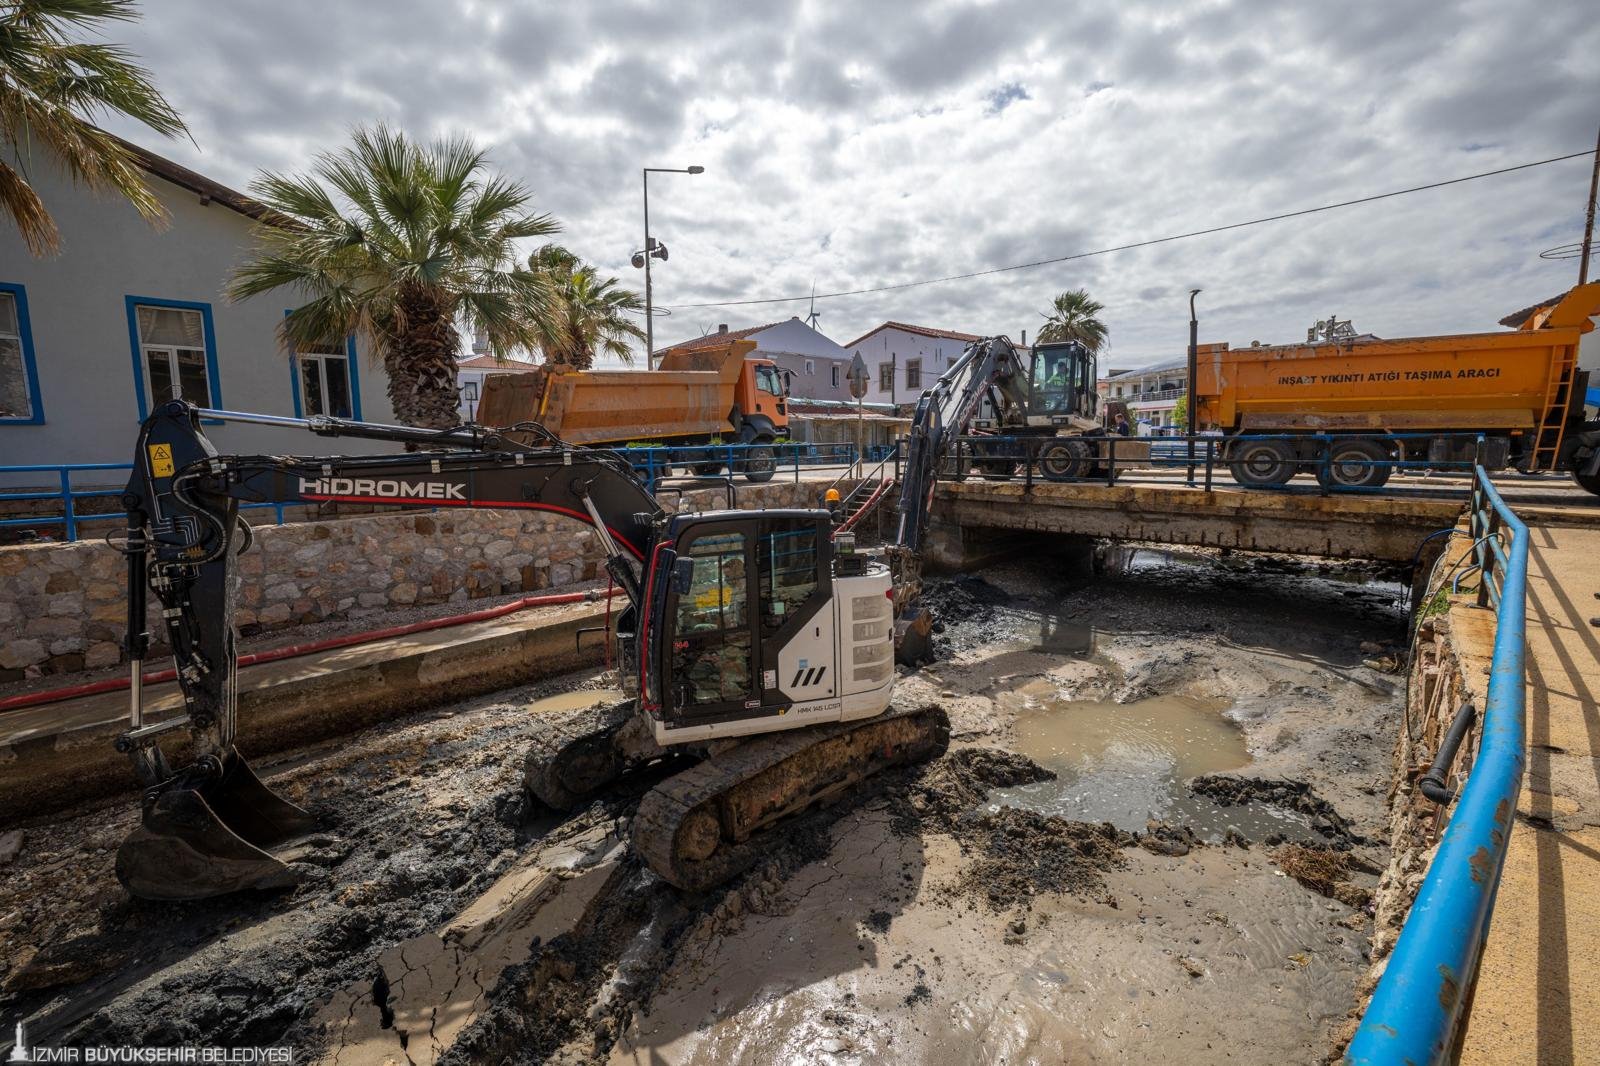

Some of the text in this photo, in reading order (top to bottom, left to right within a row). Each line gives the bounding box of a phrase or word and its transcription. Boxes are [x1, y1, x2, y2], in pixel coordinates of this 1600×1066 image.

[1320, 373, 1364, 384] YIKINTI
[1367, 370, 1400, 382] ATIĞI
[1404, 370, 1452, 381] TAŞIMA
[1457, 368, 1501, 378] ARACI
